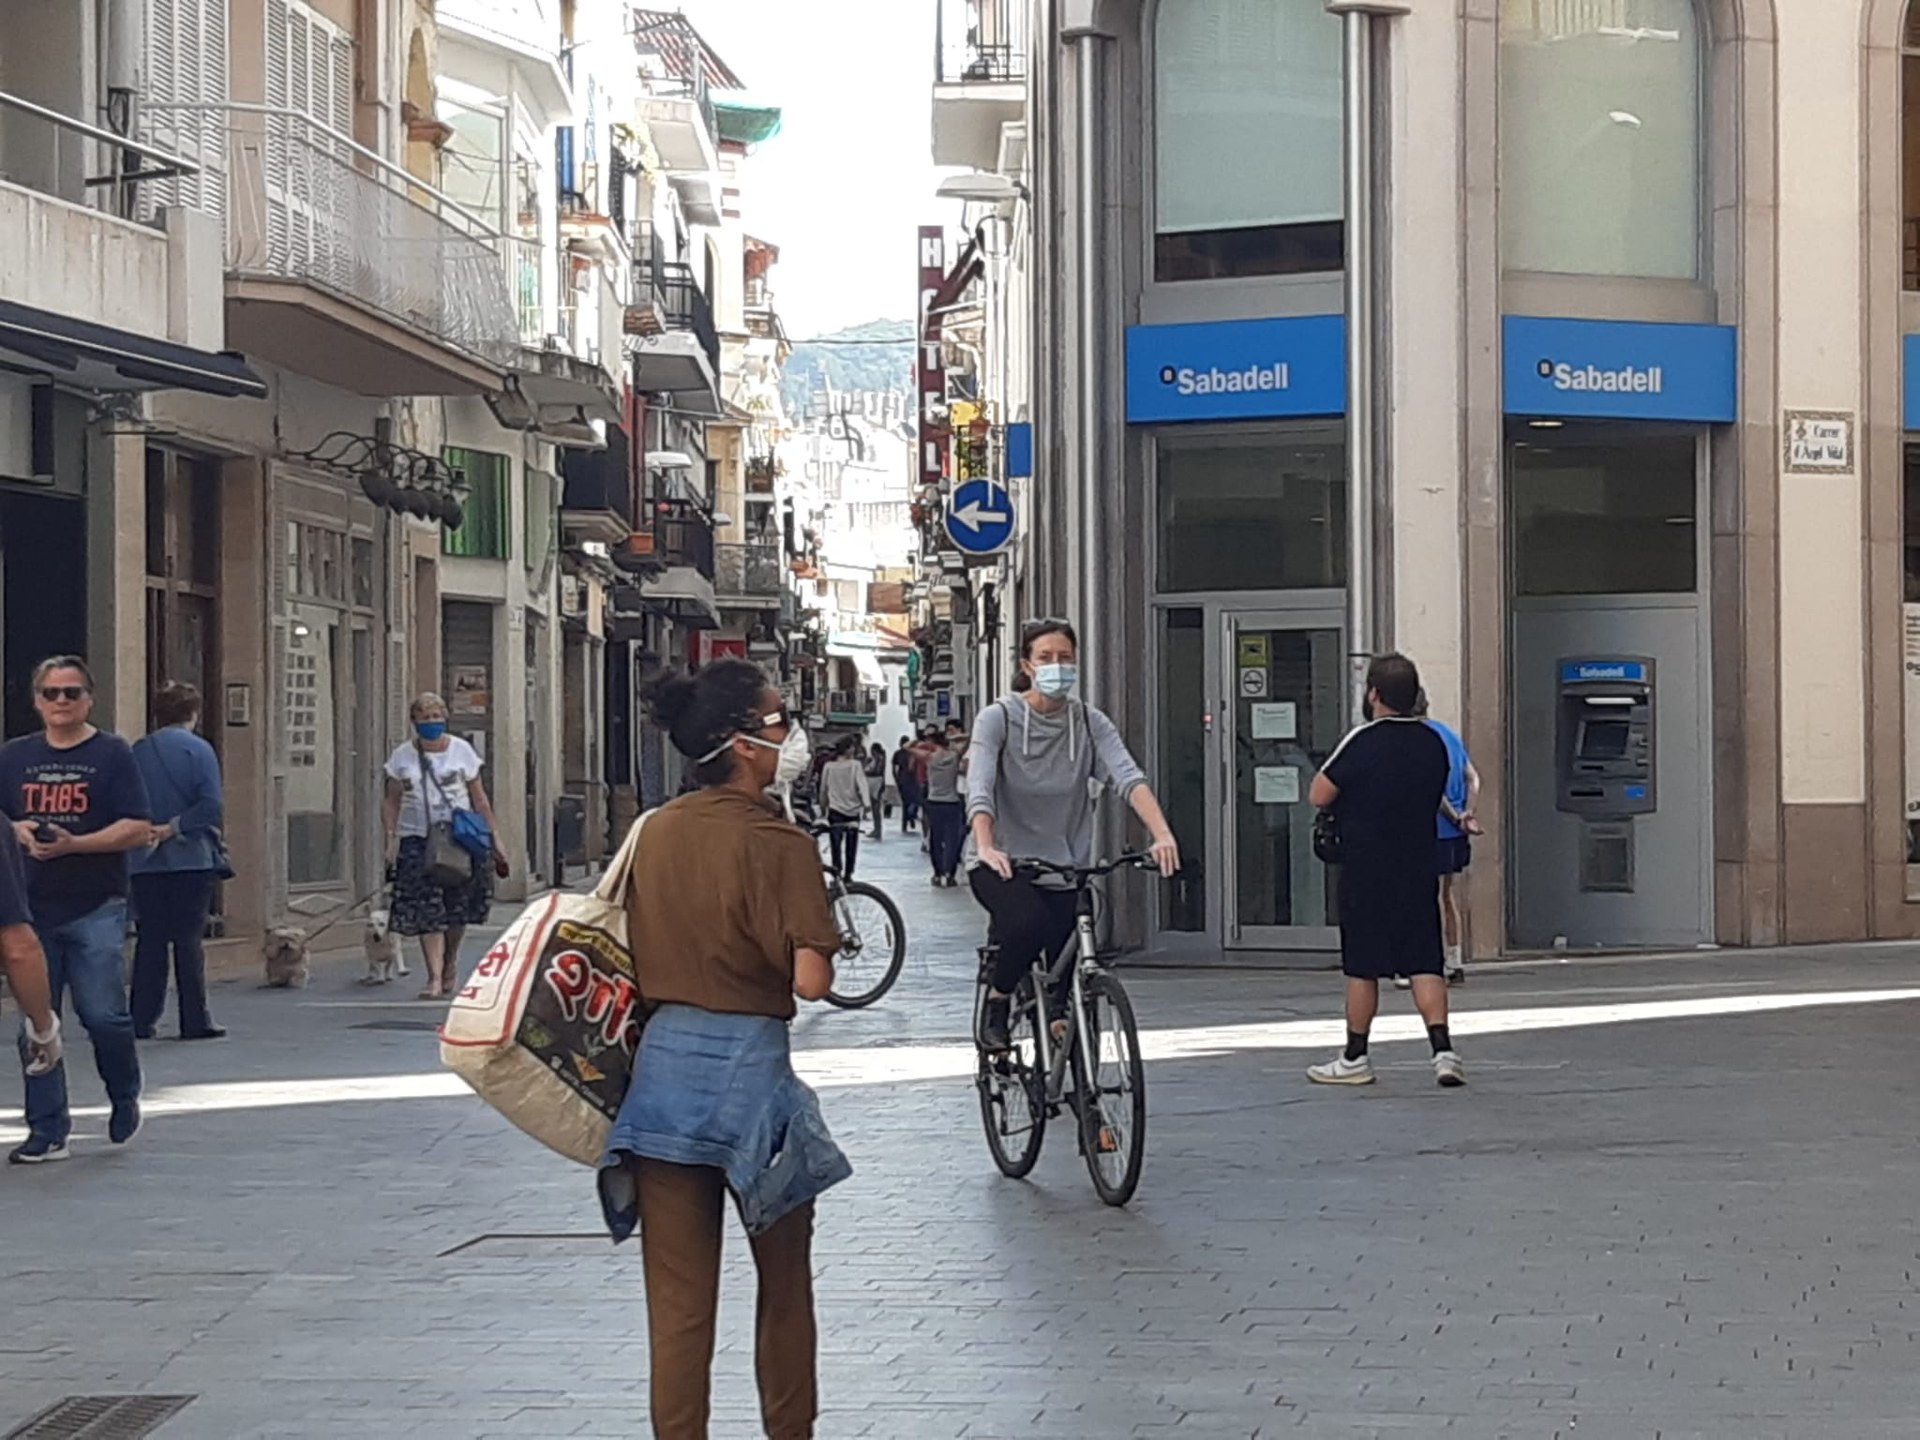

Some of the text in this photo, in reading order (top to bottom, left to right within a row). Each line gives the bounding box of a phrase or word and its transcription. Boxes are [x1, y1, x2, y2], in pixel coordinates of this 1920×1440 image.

[1177, 362, 1289, 395] Sabadell
[1554, 362, 1662, 393] Sabadell
[22, 783, 89, 814] TH85
